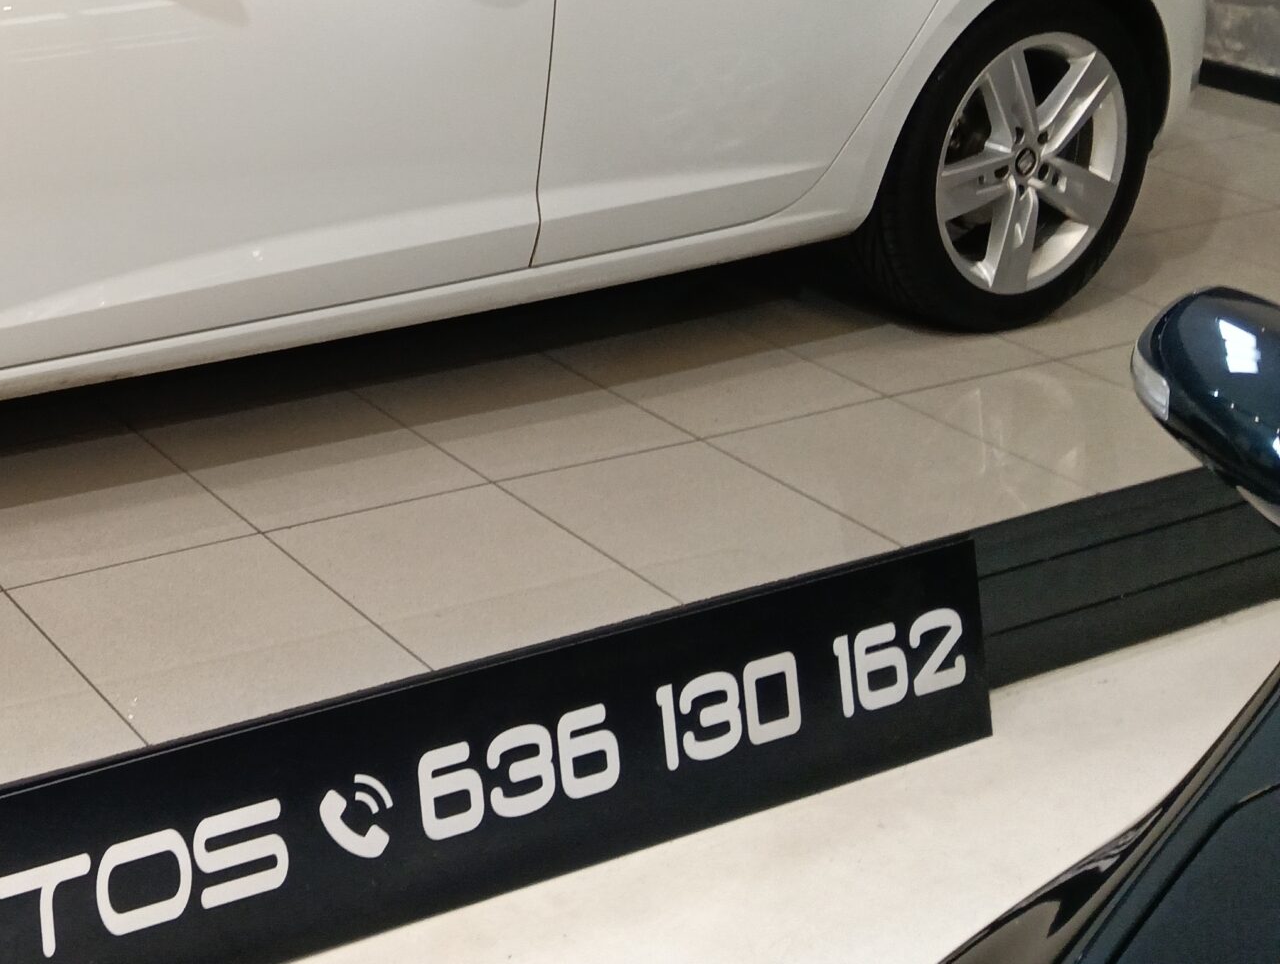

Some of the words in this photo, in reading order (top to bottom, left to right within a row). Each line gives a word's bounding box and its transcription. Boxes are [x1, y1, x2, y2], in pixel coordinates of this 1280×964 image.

[417, 702, 620, 841] 636
[655, 651, 802, 772] 130
[832, 607, 967, 719] 162
